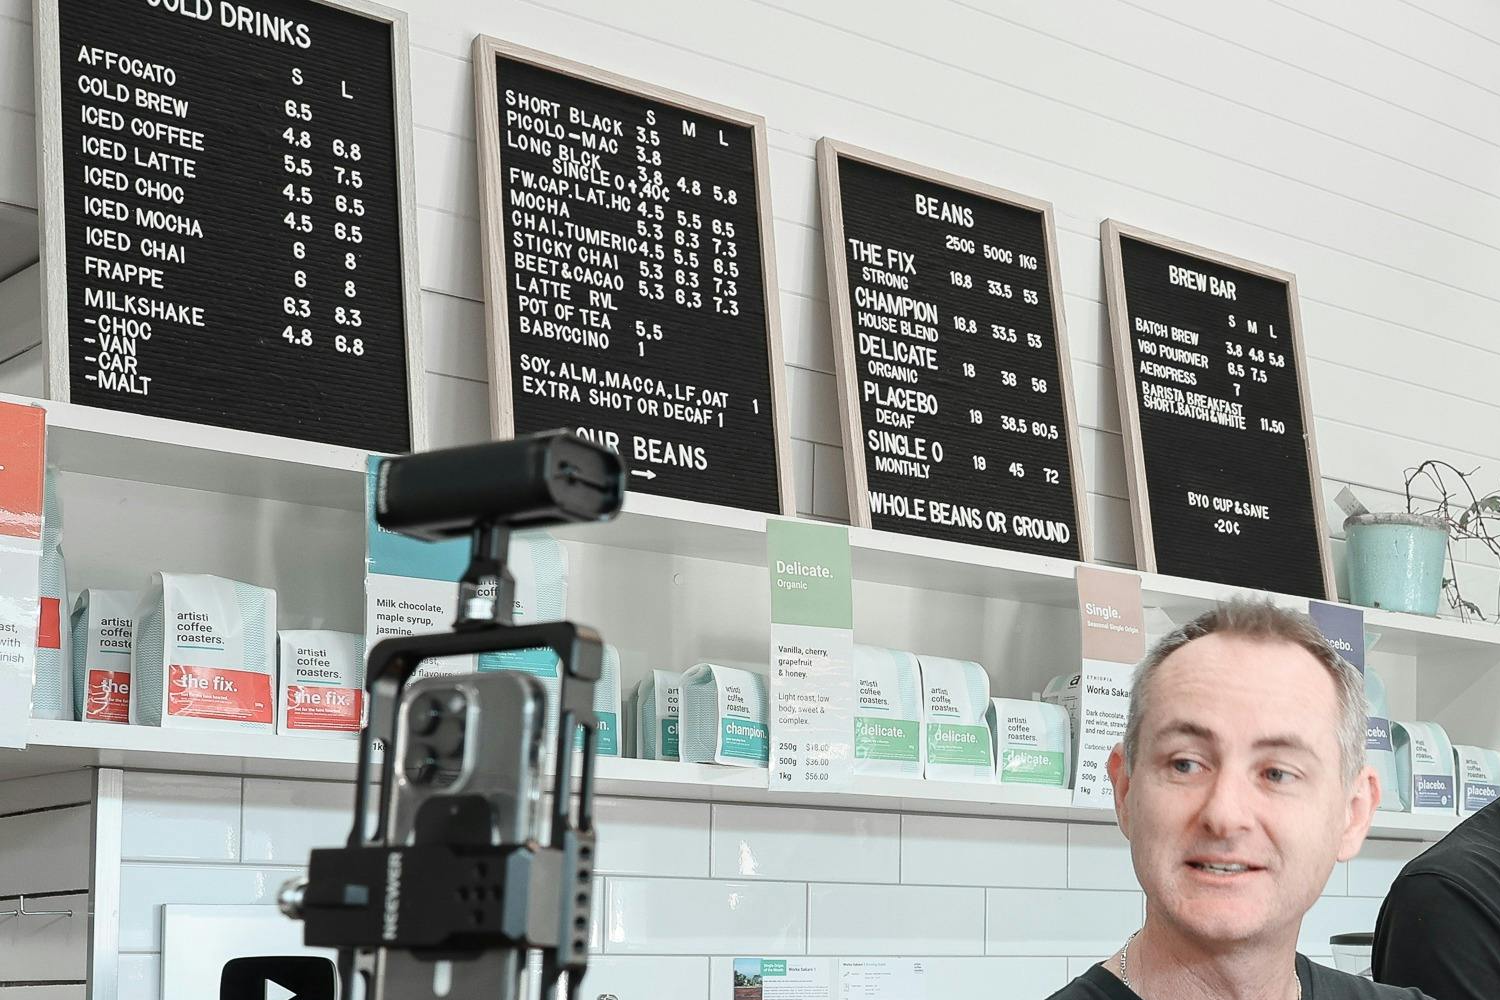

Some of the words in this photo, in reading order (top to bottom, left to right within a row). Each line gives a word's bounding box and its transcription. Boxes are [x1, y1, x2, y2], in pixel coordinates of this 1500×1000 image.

[147, 0, 212, 20] OLD
[220, 1, 311, 48] DRINKS
[78, 45, 176, 86] AFFOGATO
[292, 68, 303, 85] S
[342, 81, 353, 99] L
[78, 75, 130, 102] COLD
[135, 88, 188, 118] BREW
[285, 100, 312, 121] 6.5
[506, 90, 560, 119] SHORT
[570, 107, 623, 137] BLACK
[636, 126, 660, 146] 3.5
[82, 105, 124, 130] ICED
[131, 118, 204, 151] COFFEE
[283, 127, 311, 148] 4.8
[646, 110, 656, 125] S
[682, 120, 696, 137] M
[719, 130, 729, 146] L
[83, 135, 127, 161] ICED
[134, 147, 196, 178] LATTE
[284, 154, 312, 176] 5.5
[507, 130, 551, 157] LONG
[559, 144, 601, 171] BLCK
[637, 166, 663, 186] 3.8
[636, 145, 662, 166] 3.8
[552, 158, 611, 187] SINGLE
[84, 165, 129, 191] ICED
[135, 178, 184, 204] CHOC
[283, 183, 313, 205] 4.5
[85, 196, 129, 221] ICED
[136, 208, 203, 238] MOCHA
[510, 189, 570, 218] MOCHA
[637, 220, 663, 240] 5.3
[637, 201, 664, 221] 4.5
[915, 194, 974, 228] BEANS
[284, 212, 313, 233] 4.5
[86, 226, 131, 251] ICED
[140, 238, 185, 264] CHAI
[513, 231, 572, 259] STICKY
[578, 246, 618, 270] CHAI
[640, 261, 663, 280] 5.3
[639, 241, 665, 260] 4.5
[946, 235, 975, 254] 250G
[983, 244, 1012, 264] 500G
[1019, 254, 1037, 270] 1KG
[848, 238, 883, 266] THE
[887, 248, 916, 275] FIX
[85, 256, 164, 289] FRAPPE
[862, 266, 909, 290] STRONG
[1169, 265, 1207, 292] BREW
[1209, 276, 1236, 301] BAR
[516, 273, 571, 300] LATTE
[589, 290, 618, 310] RVL
[639, 280, 664, 300] 5.3
[950, 271, 972, 289] 16.8
[987, 280, 1012, 299] 33.5
[1023, 289, 1038, 305] 53
[85, 288, 205, 326] MILKSHAKE
[284, 297, 311, 318] 6.3
[855, 286, 938, 325] CHAMPION
[519, 295, 548, 317] POT
[555, 303, 574, 321] OF
[579, 308, 611, 330] TEA
[636, 320, 663, 340] 5.5
[858, 311, 898, 333] HOUSE
[900, 320, 938, 342] BLEND
[282, 325, 313, 346] 4.8
[520, 316, 609, 349] BABYCCINO
[953, 316, 977, 334] 16.8
[991, 324, 1017, 343] 33.5
[1027, 333, 1042, 348] 53
[1135, 317, 1168, 338] BATCH
[1171, 327, 1199, 346] BREW
[859, 333, 938, 370] DELICATE
[1159, 344, 1209, 369] POUROVER
[868, 360, 918, 383] ORGANIC
[1140, 360, 1197, 385] AEROPRESS
[523, 375, 581, 402] EXTRA
[589, 388, 633, 411] SHOT
[637, 398, 658, 416] OR
[663, 402, 713, 425] DECAF
[864, 381, 938, 415] PLACEBO
[1142, 381, 1185, 403] BARISTA
[1186, 391, 1243, 416] BREAKFAST
[876, 408, 915, 429] DECAF
[1260, 418, 1285, 434] 11.50
[633, 436, 707, 470] BEANS
[868, 429, 927, 460] SINGLE
[875, 456, 930, 479] MONTHLY
[1188, 492, 1209, 508] BYO
[868, 490, 927, 521] WHOLE
[929, 501, 983, 529] BEANS
[986, 511, 1007, 533] OR
[1012, 515, 1070, 543] GROUND
[776, 560, 834, 579] Delicate.
[777, 579, 808, 590] Organic
[376, 598, 396, 608] Milk
[398, 601, 444, 614] chocolate,
[1086, 603, 1121, 619] Single.
[177, 612, 209, 622] artisti
[177, 622, 213, 633] coffee
[376, 613, 404, 623] maple
[407, 616, 434, 627] syrup,
[177, 633, 225, 645] roasters.
[376, 625, 415, 636] jasmine.
[297, 648, 327, 657] artisti
[778, 646, 804, 656] Vanilla,
[297, 657, 330, 668] coffee
[778, 659, 812, 667] grapefruit
[180, 674, 209, 690] the
[213, 675, 238, 692] fix.
[296, 668, 342, 679] roasters.
[785, 670, 808, 679] honey.
[101, 678, 130, 694] the
[1087, 685, 1110, 696] Worka
[295, 690, 321, 704] the
[326, 691, 351, 706] fix.
[726, 723, 767, 739] champion.
[860, 723, 906, 738] delicate.
[934, 730, 978, 744] delicate.
[1007, 724, 1030, 733] coffee
[1007, 732, 1038, 742] roasters.
[779, 742, 797, 751] 250g
[779, 757, 797, 766] 500g
[1007, 750, 1052, 766] delicate.
[1083, 761, 1098, 769] 200g
[778, 772, 792, 780] 1kg
[1082, 774, 1096, 782] 500g
[1418, 778, 1447, 791] placebo.
[1467, 785, 1497, 797] placebo.
